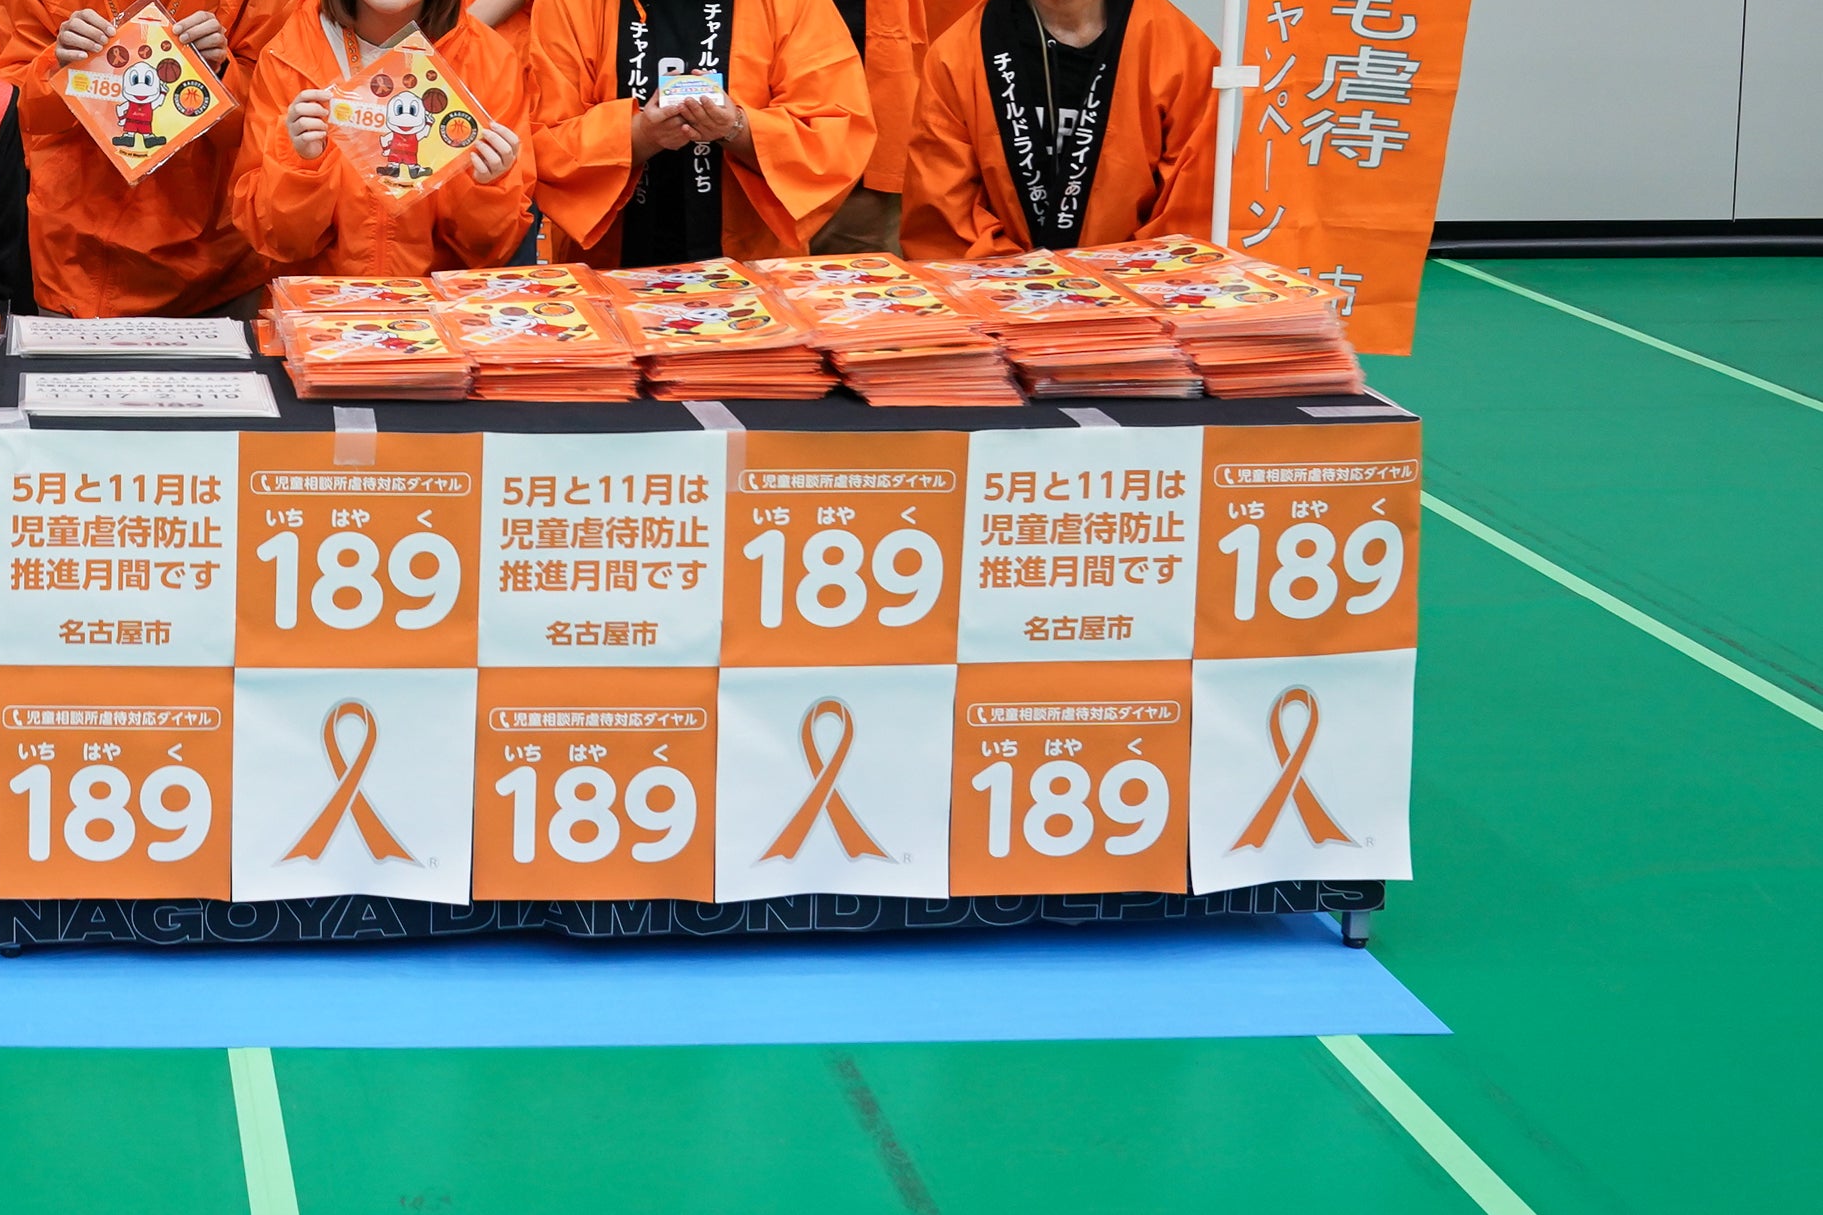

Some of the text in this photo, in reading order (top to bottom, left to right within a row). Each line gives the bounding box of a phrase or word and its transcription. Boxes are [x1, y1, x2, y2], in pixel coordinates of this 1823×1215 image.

[91, 79, 122, 98] 189
[354, 109, 386, 129] 189
[275, 475, 462, 493] 児童相談所虐待対応ダイヤル
[761, 472, 947, 489] 児童相談所虐待対応ダイヤル
[983, 469, 1187, 503] 5月と11月は
[1237, 464, 1413, 484] 児童相談所虐待対応ダイヤル
[12, 473, 223, 506] 5月と11月は
[502, 473, 710, 507] 5月と11月は
[265, 508, 434, 528] いち はや く
[752, 506, 917, 526] いち はや く
[1228, 497, 1386, 520] いち はや く
[10, 514, 223, 550] 児童虐待防止
[499, 516, 710, 550] 児童虐待防止
[979, 511, 1186, 546] 児童虐待防止
[10, 558, 222, 591] 推進月間です
[256, 530, 461, 631] 189
[499, 558, 708, 593] 推進月間です
[742, 528, 944, 629] 189
[979, 554, 1184, 589] 推進月間です
[1218, 520, 1405, 622] 189
[58, 619, 173, 646] 名古屋市
[545, 620, 659, 647] 名古屋市
[1023, 615, 1134, 642] 名古屋市
[26, 709, 212, 727] 児童相談所虐待対応ダイヤル
[513, 712, 697, 729] 児童相談所虐待対応ダイヤル
[990, 705, 1172, 724] 児童相談所虐待対応ダイヤル
[18, 742, 184, 762] いち はや く
[504, 744, 669, 763] いち はや く
[981, 737, 1143, 757] いち はや く
[9, 763, 213, 862] 189
[495, 765, 698, 864] 189
[971, 758, 1171, 859] 189
